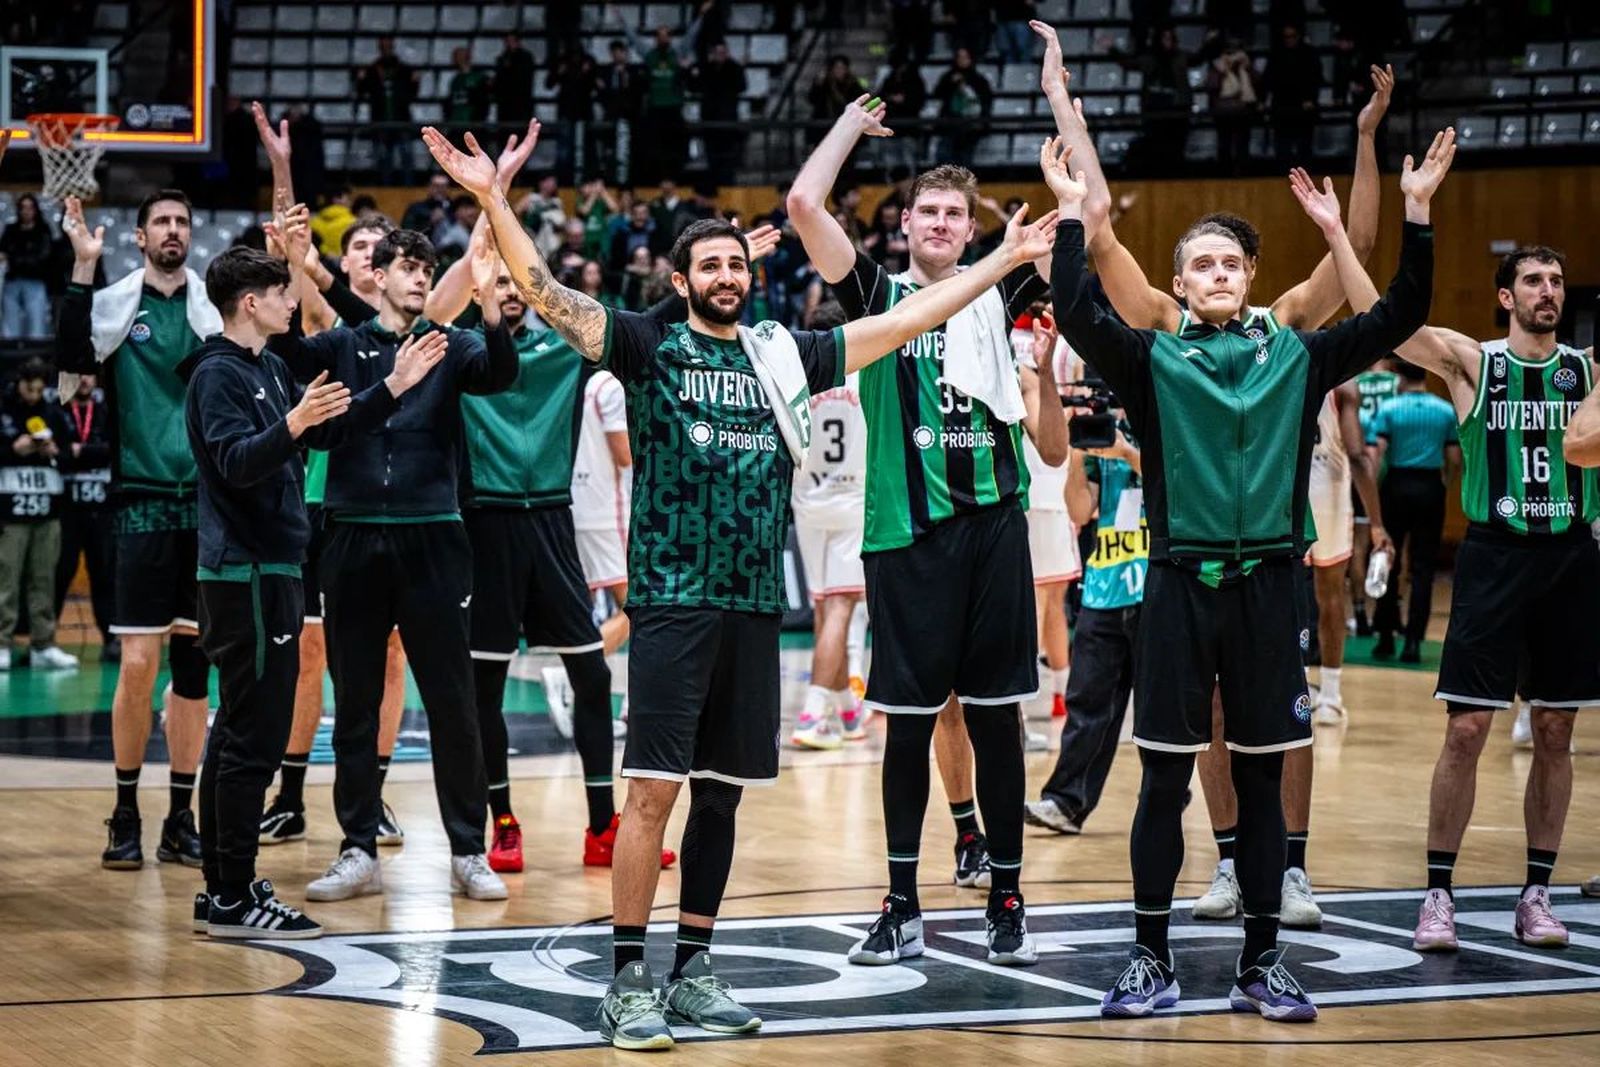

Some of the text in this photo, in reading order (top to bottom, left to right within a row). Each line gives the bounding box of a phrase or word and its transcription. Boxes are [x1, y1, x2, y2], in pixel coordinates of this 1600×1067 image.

[901, 331, 947, 360] JOVE
[678, 369, 771, 409] JOVENTU
[823, 419, 844, 463] 3
[940, 432, 995, 448] PROBITAS
[1521, 447, 1550, 483] 16
[1522, 503, 1576, 517] PROBITA
